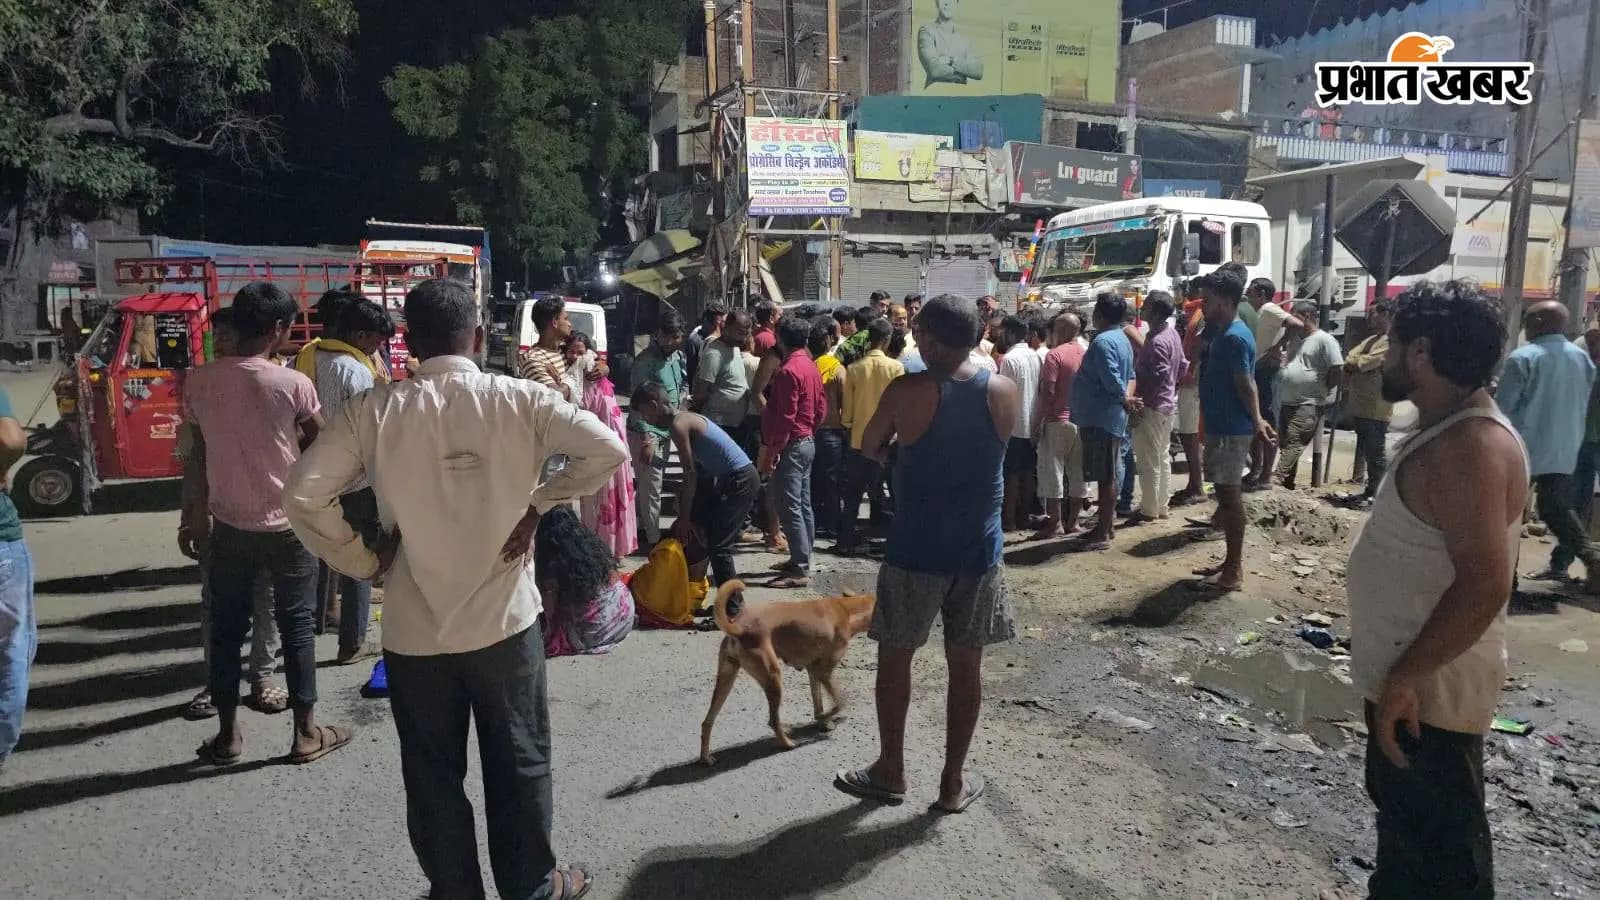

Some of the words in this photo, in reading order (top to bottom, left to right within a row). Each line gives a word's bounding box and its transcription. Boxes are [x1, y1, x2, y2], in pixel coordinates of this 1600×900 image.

[1008, 37, 1042, 46] UltraTech
[751, 123, 843, 142] हॉस्टल
[1058, 161, 1119, 184] Livguard
